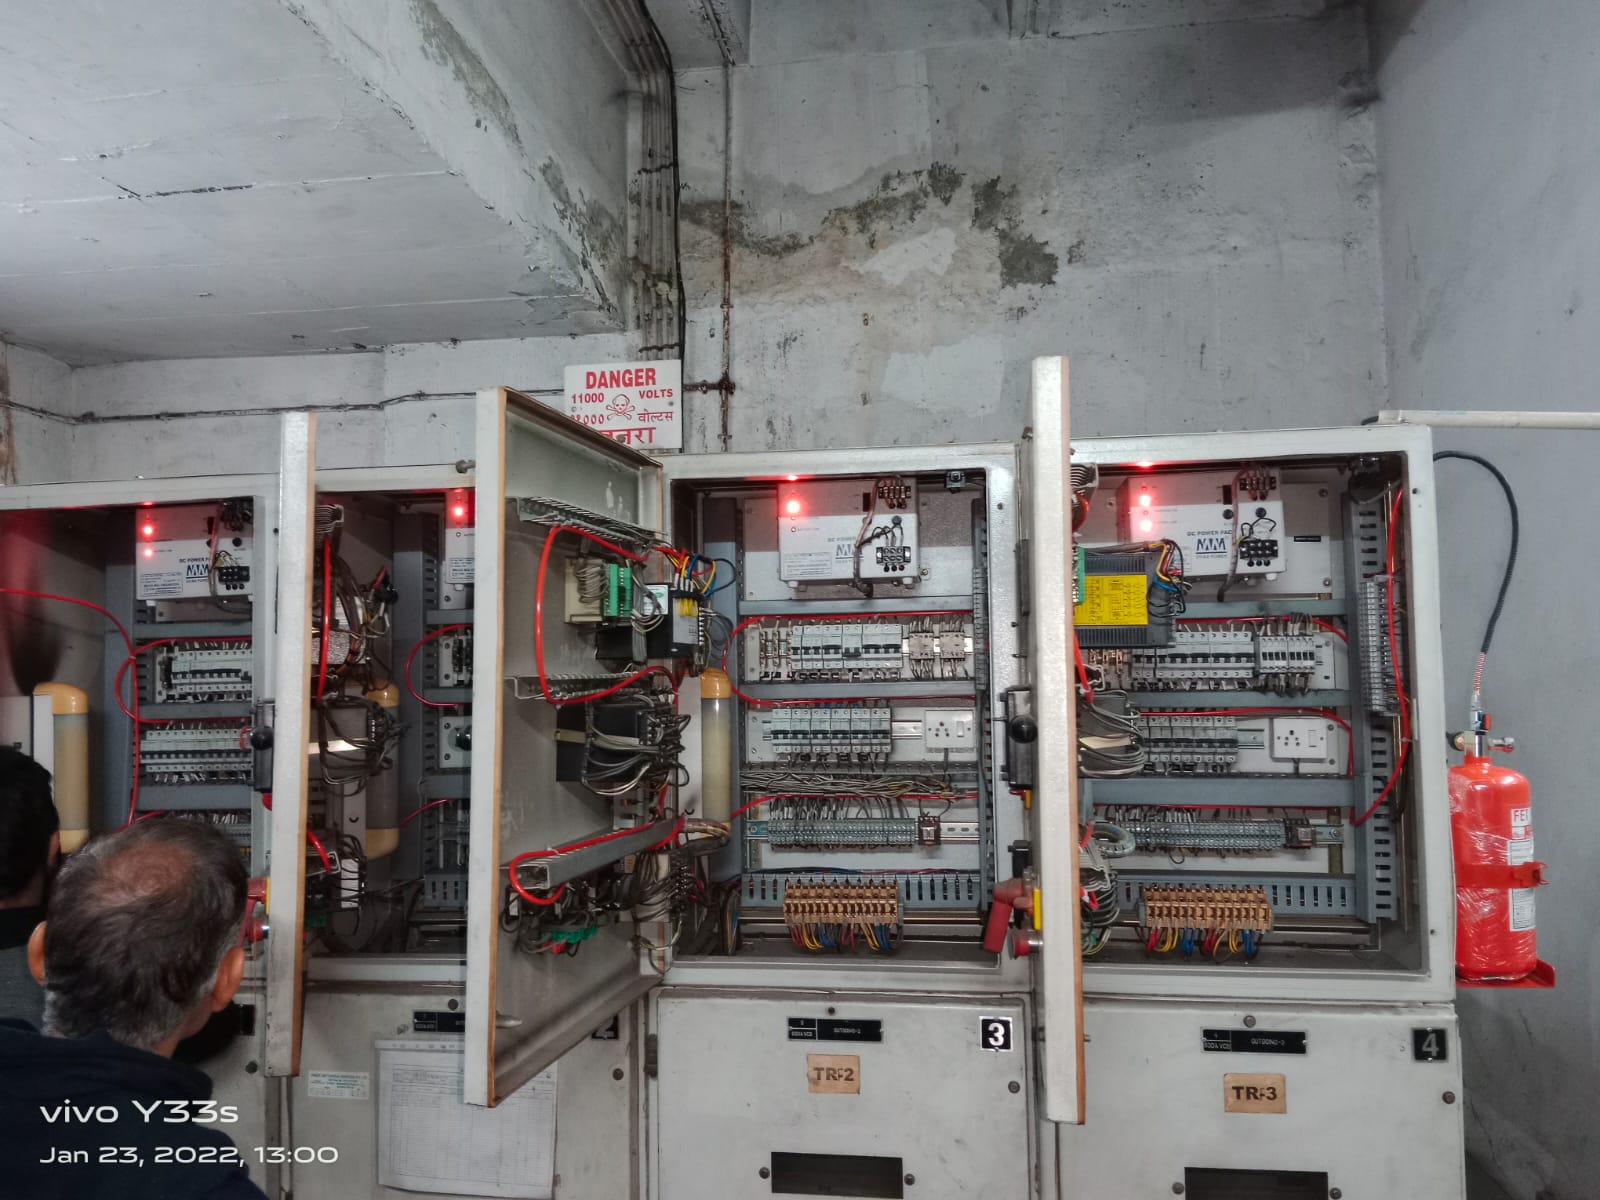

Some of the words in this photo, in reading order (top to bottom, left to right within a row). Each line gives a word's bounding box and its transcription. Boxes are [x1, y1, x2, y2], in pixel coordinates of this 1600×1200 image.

[586, 368, 656, 390] DANGER
[572, 392, 605, 403] 11000
[639, 388, 673, 399] VOLTS
[988, 1022, 1005, 1046] 3
[1422, 1033, 1439, 1057] 4
